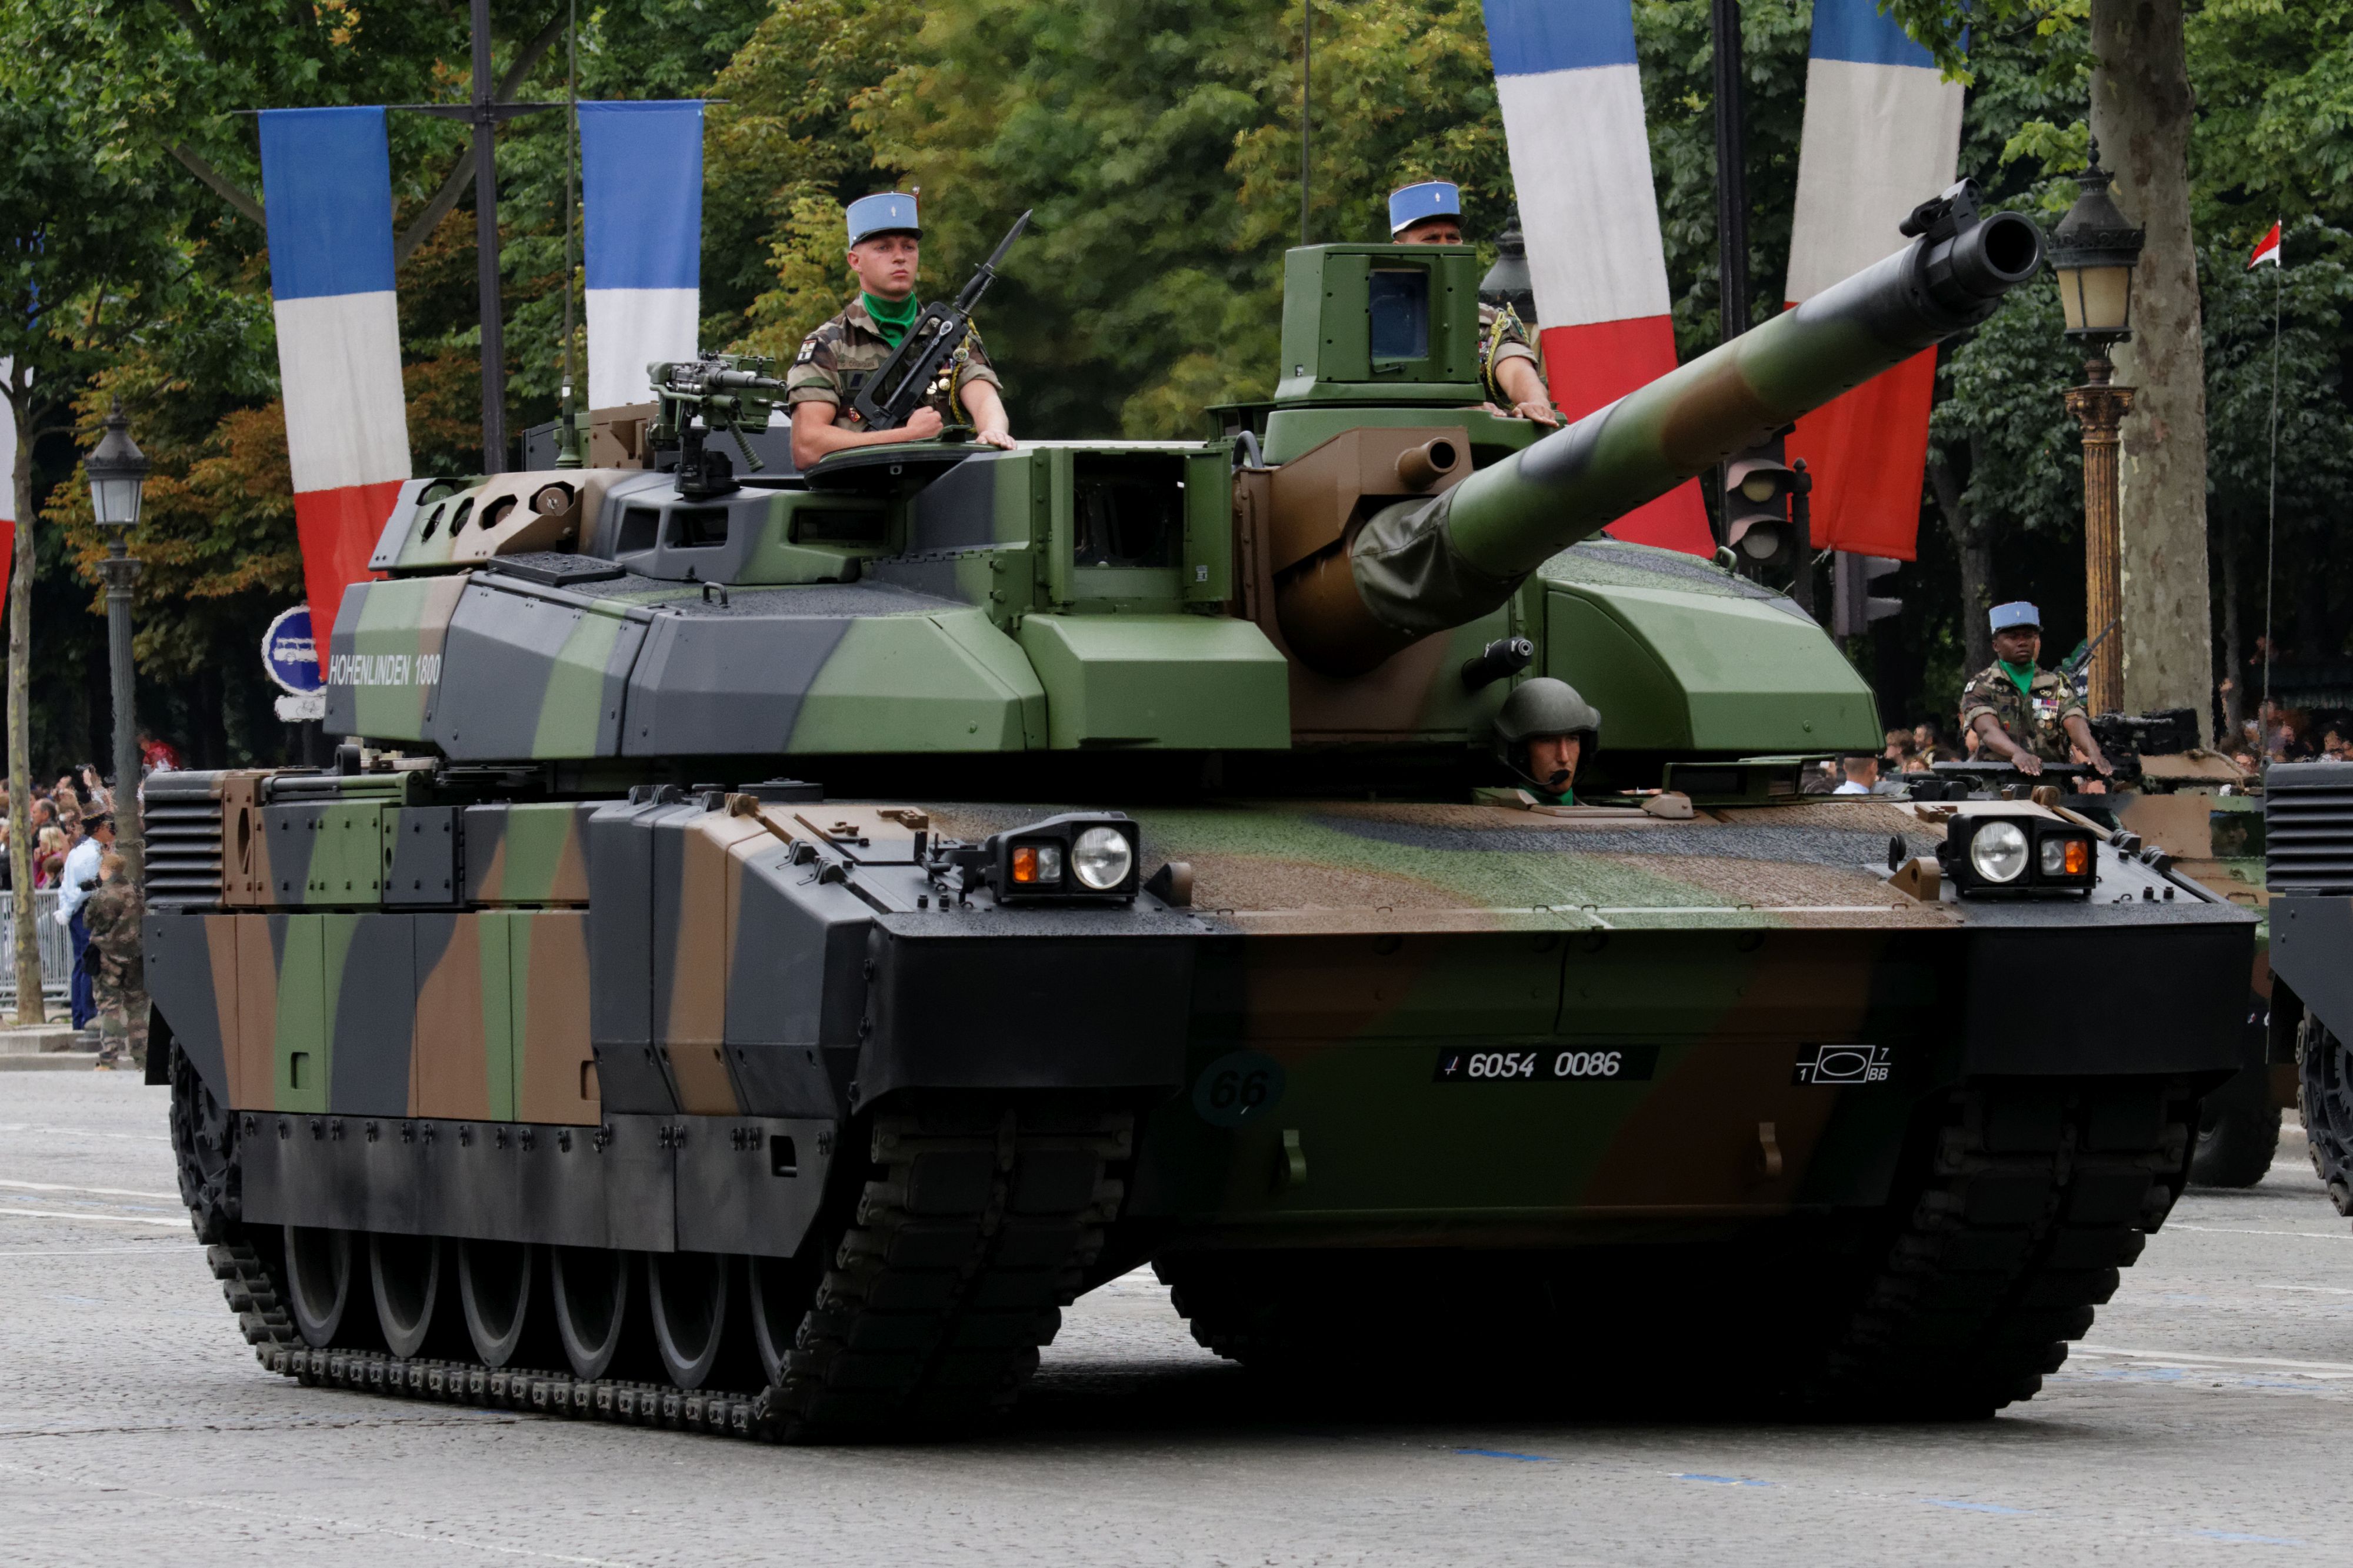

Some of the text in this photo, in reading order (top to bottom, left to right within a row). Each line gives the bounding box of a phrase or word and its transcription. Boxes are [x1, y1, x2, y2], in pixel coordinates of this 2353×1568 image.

[329, 654, 441, 685] HOHENLINDEN 1800
[1881, 1047, 1889, 1060] 7
[1468, 1051, 1622, 1077] 6054 0086
[1800, 1068, 1807, 1081] 1
[1868, 1068, 1888, 1080] BB
[1210, 1070, 1269, 1108] 66
